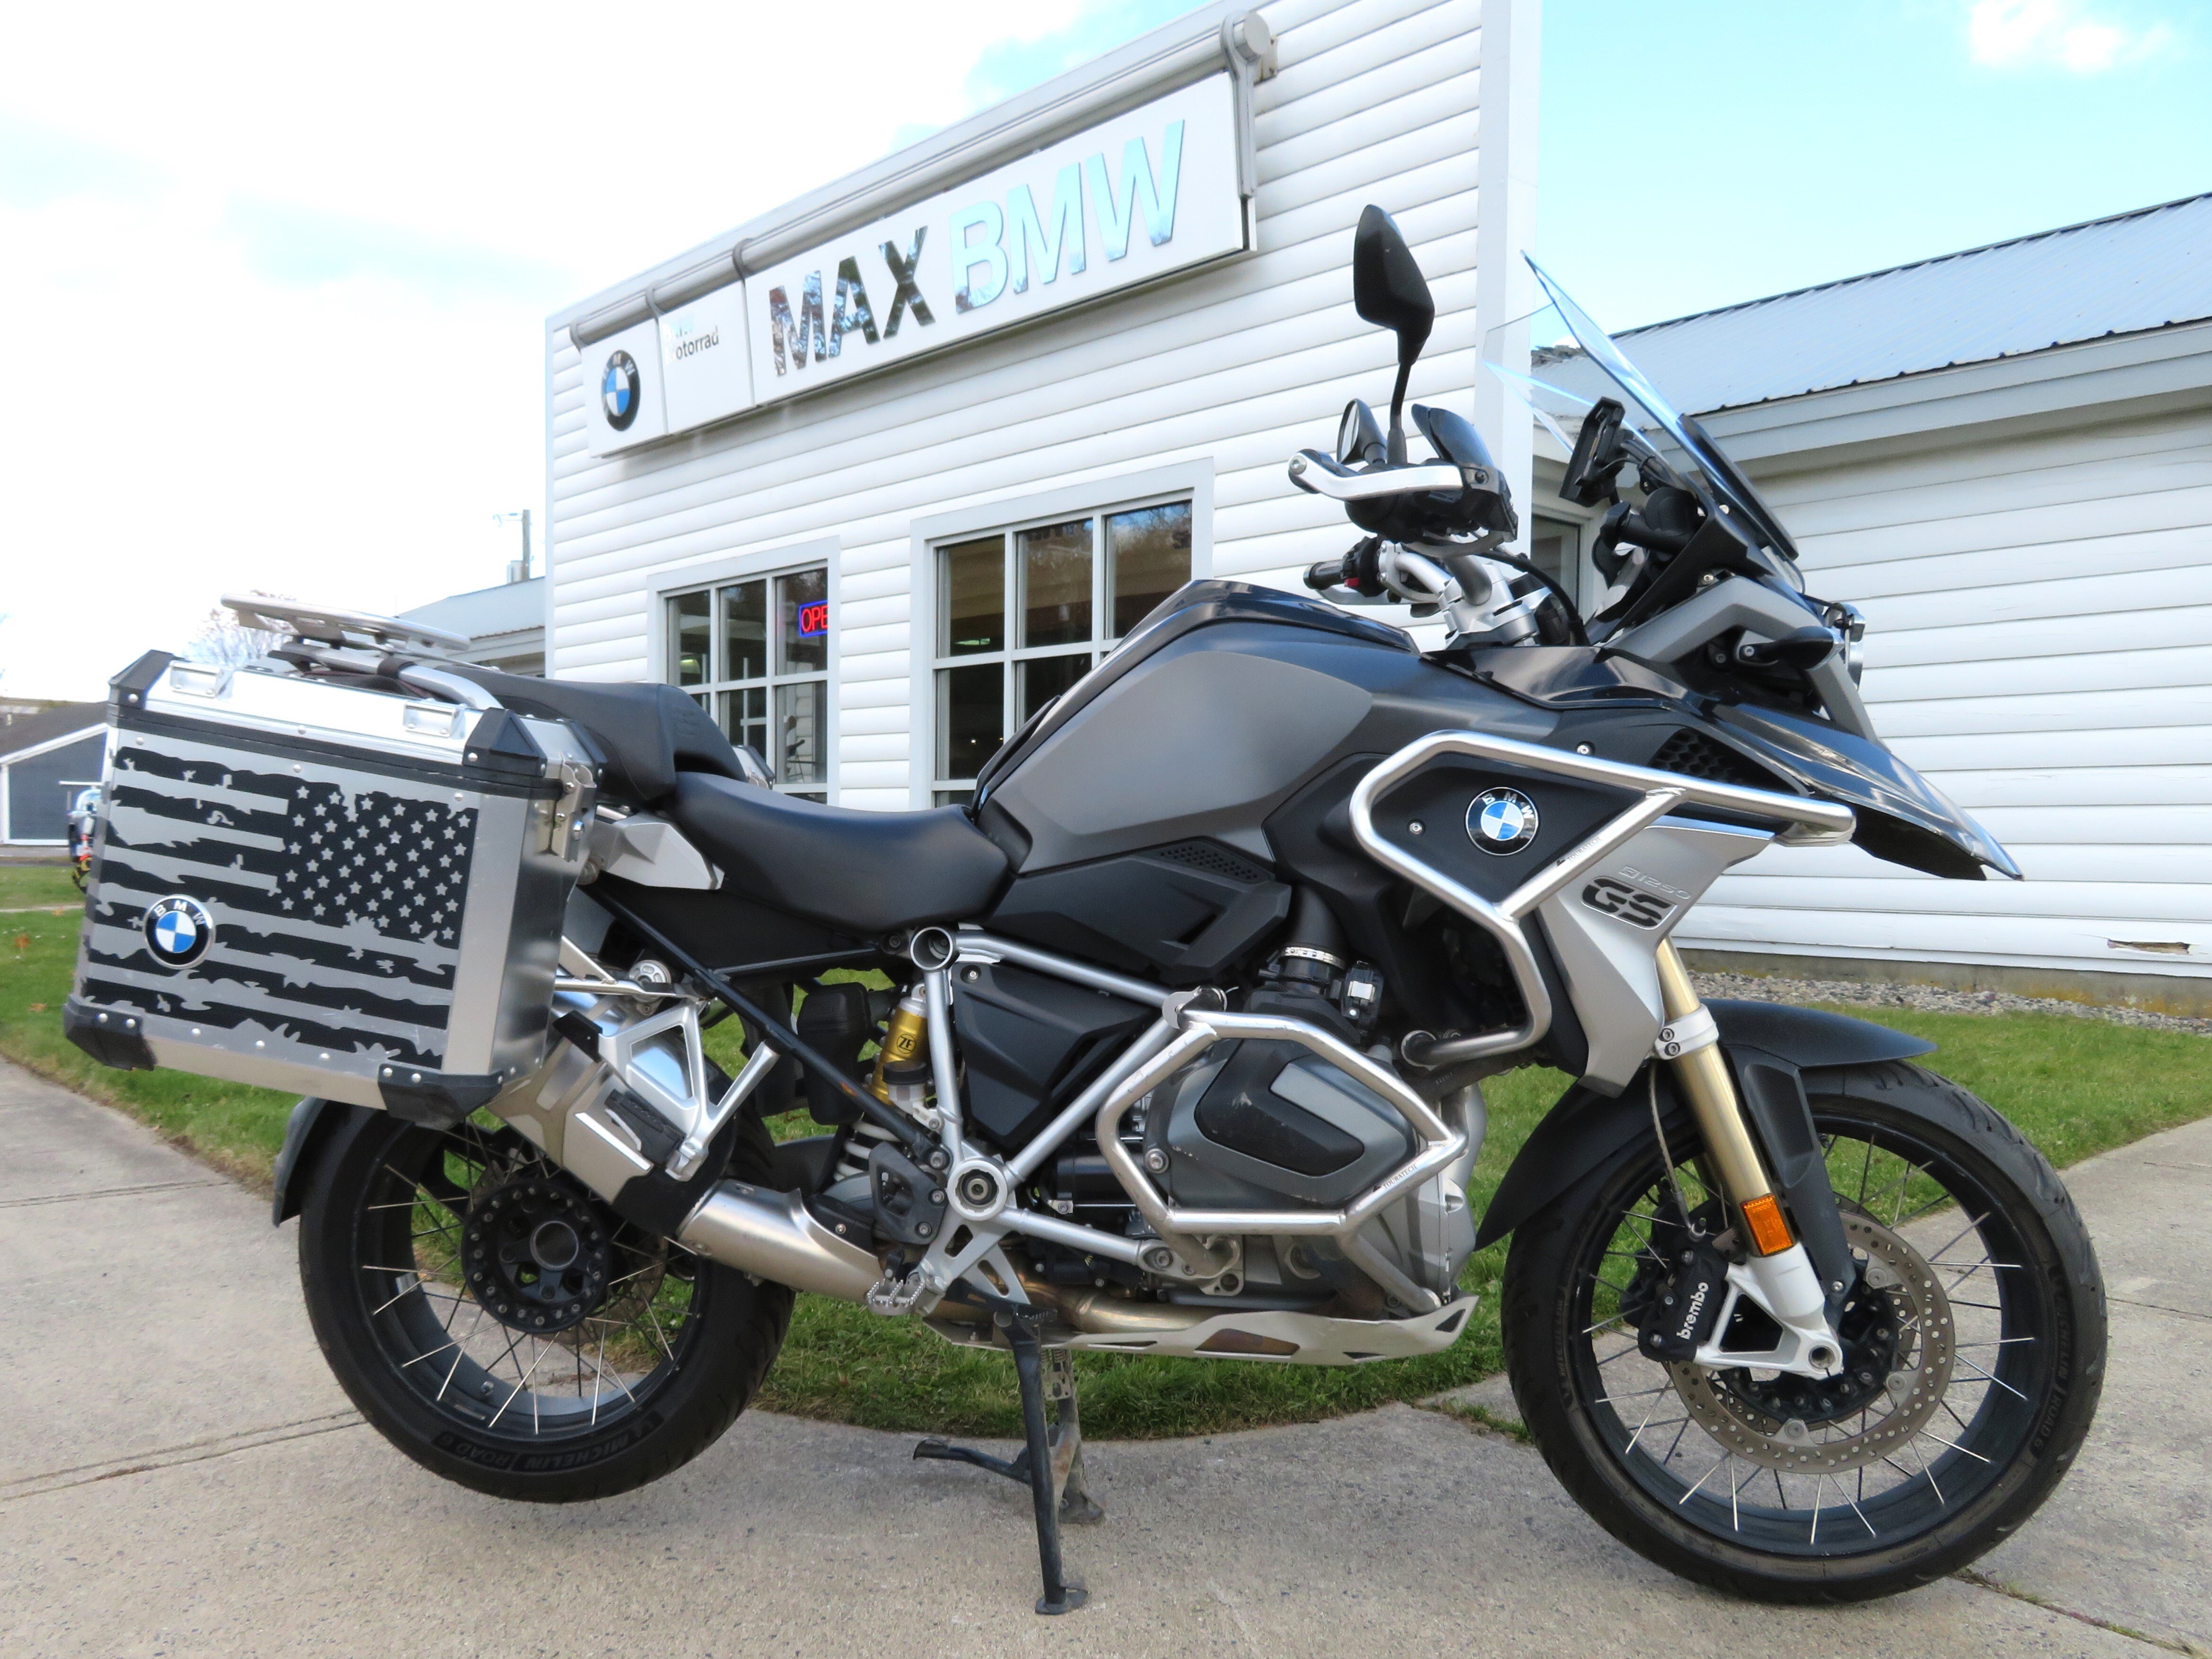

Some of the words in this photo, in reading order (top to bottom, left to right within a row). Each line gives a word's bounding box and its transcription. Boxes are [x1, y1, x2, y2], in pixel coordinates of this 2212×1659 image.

[769, 226, 936, 376] MAX
[948, 119, 1185, 314] BMW
[1481, 791, 1535, 819] BMW
[153, 900, 205, 925] BMW
[1582, 878, 1672, 927] GS
[898, 1036, 915, 1052] ZF
[1383, 1163, 1417, 1189] TOURATECH
[1676, 1282, 1709, 1340] brembo
